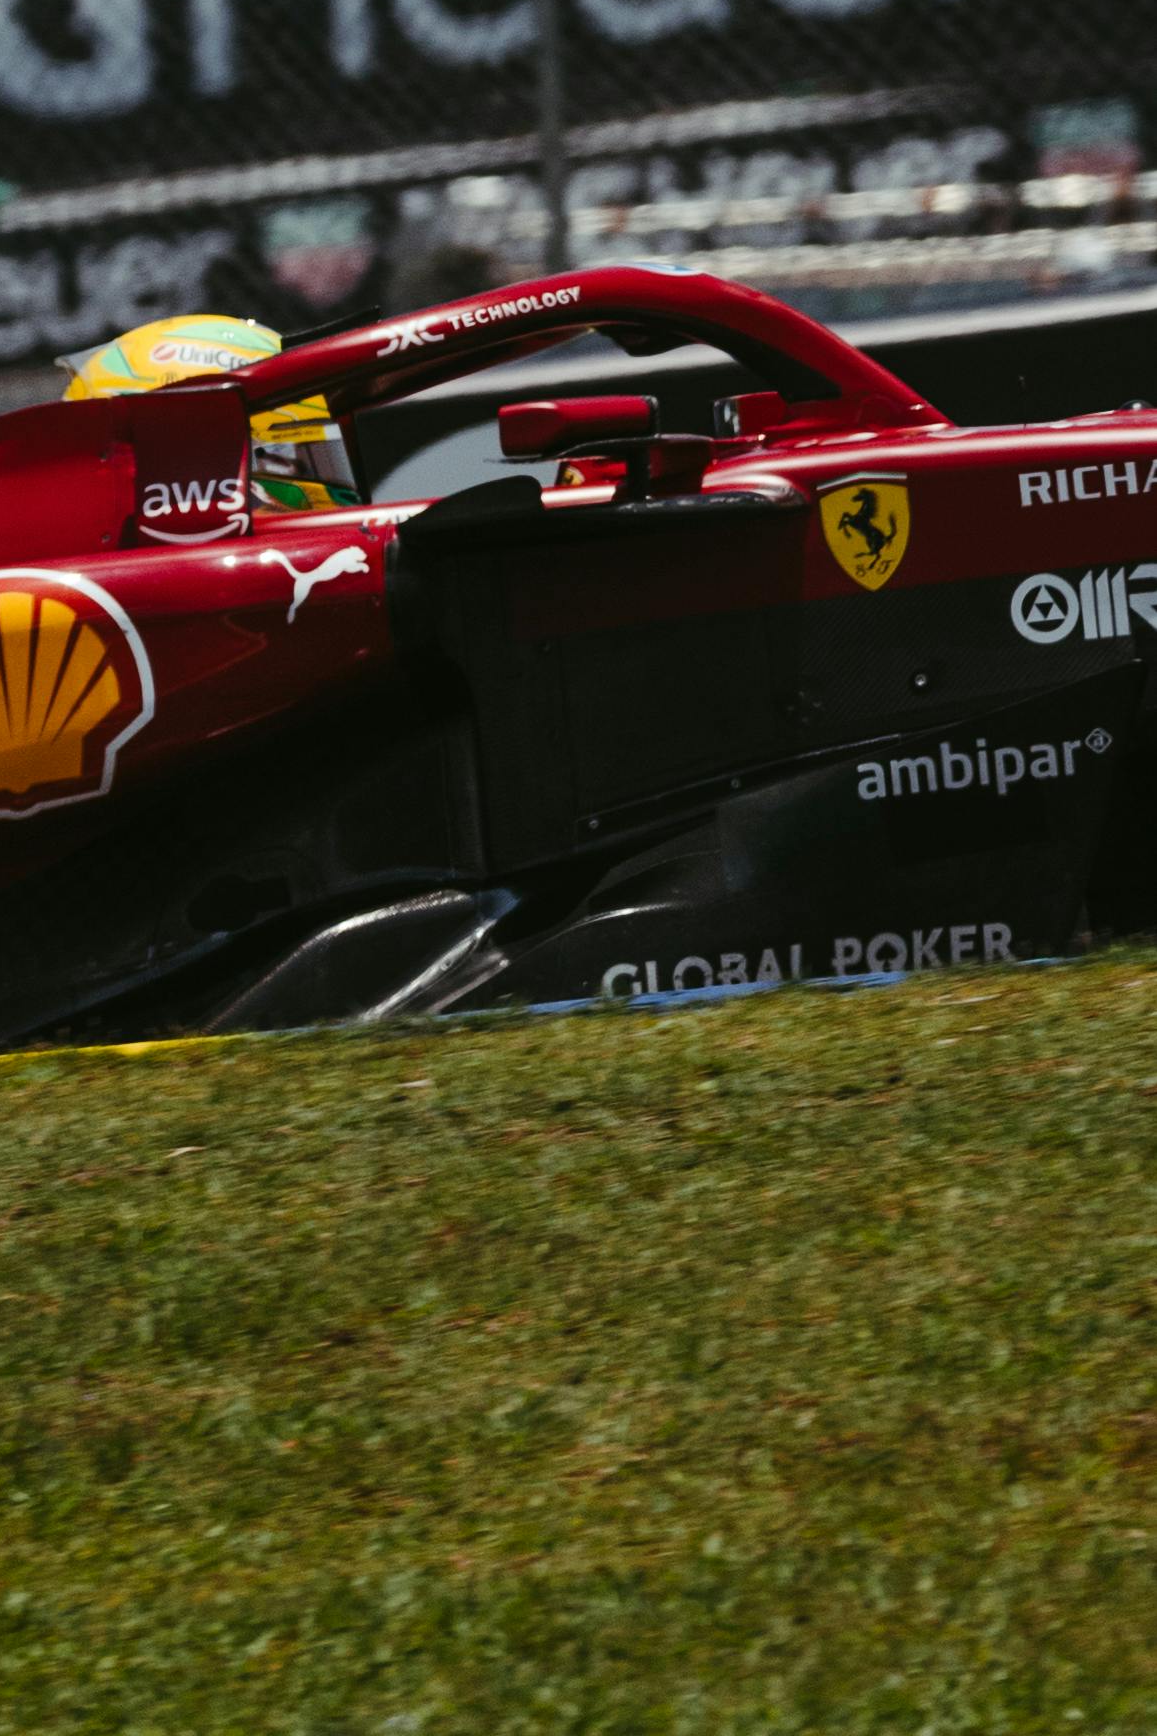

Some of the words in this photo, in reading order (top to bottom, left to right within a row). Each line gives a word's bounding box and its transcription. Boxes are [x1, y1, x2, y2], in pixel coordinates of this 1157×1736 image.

[447, 285, 582, 332] TECHNOLOGY
[142, 478, 243, 519] aws
[856, 737, 1082, 800] ambipar
[832, 922, 1017, 978] POKER
